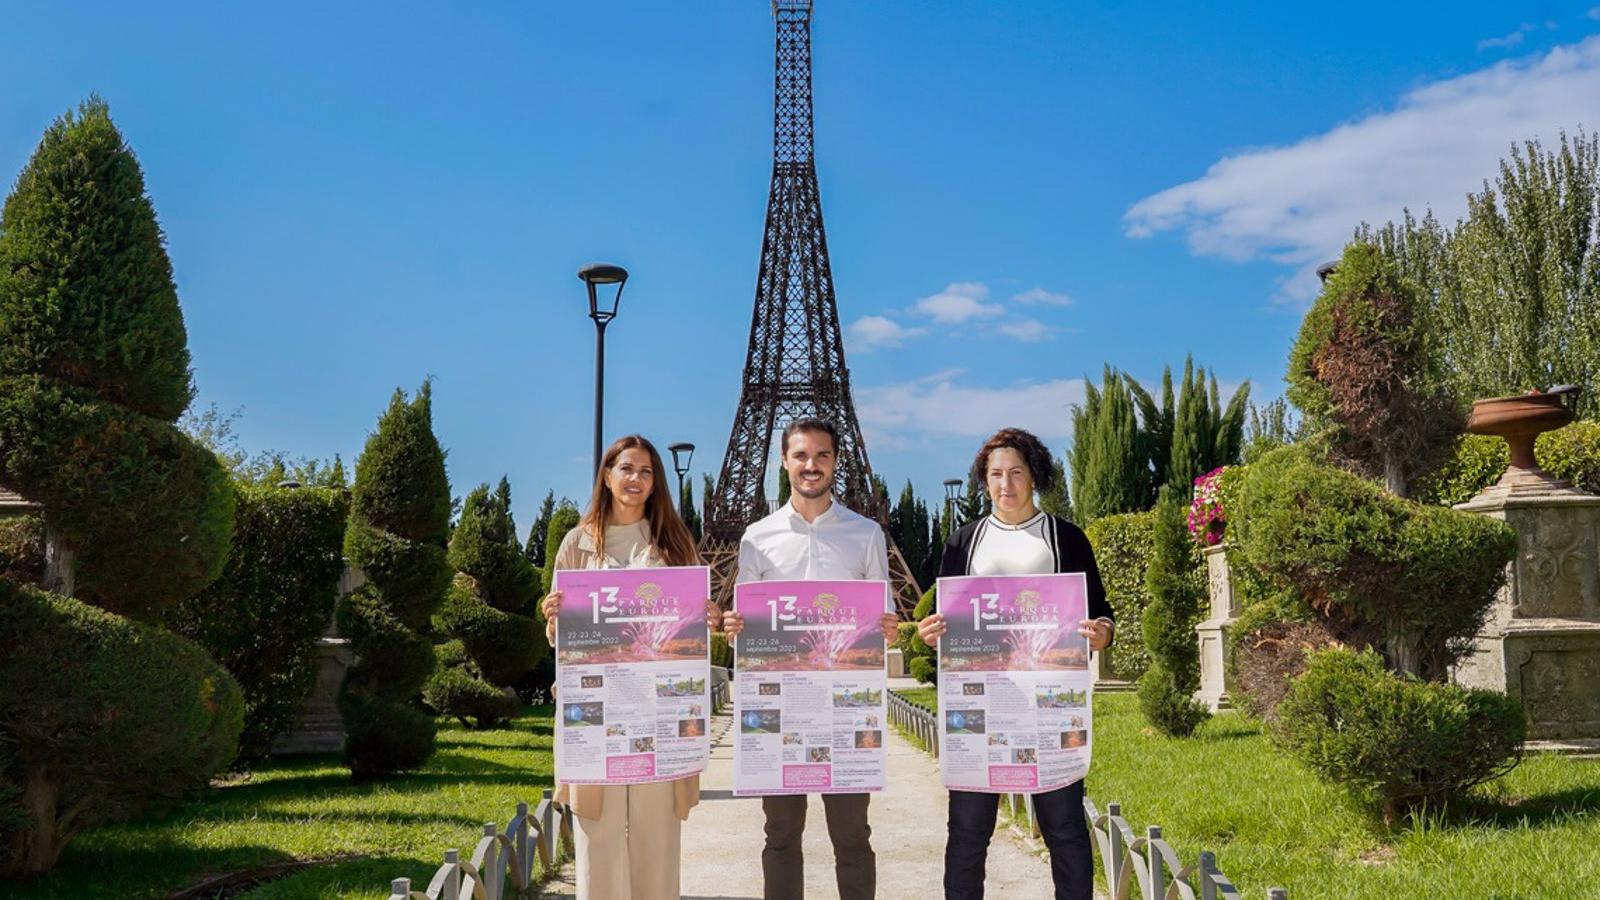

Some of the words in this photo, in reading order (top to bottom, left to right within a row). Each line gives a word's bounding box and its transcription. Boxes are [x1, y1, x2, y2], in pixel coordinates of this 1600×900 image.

[588, 586, 620, 624] 13
[618, 597, 679, 607] PARQUE
[619, 607, 679, 616] EUROPA
[767, 595, 798, 632] 13
[797, 607, 856, 616] PARQUE
[969, 593, 1000, 631] 13
[999, 606, 1058, 615] PARQUE
[796, 616, 857, 624] EUROPA
[1000, 614, 1058, 624] EUROPA
